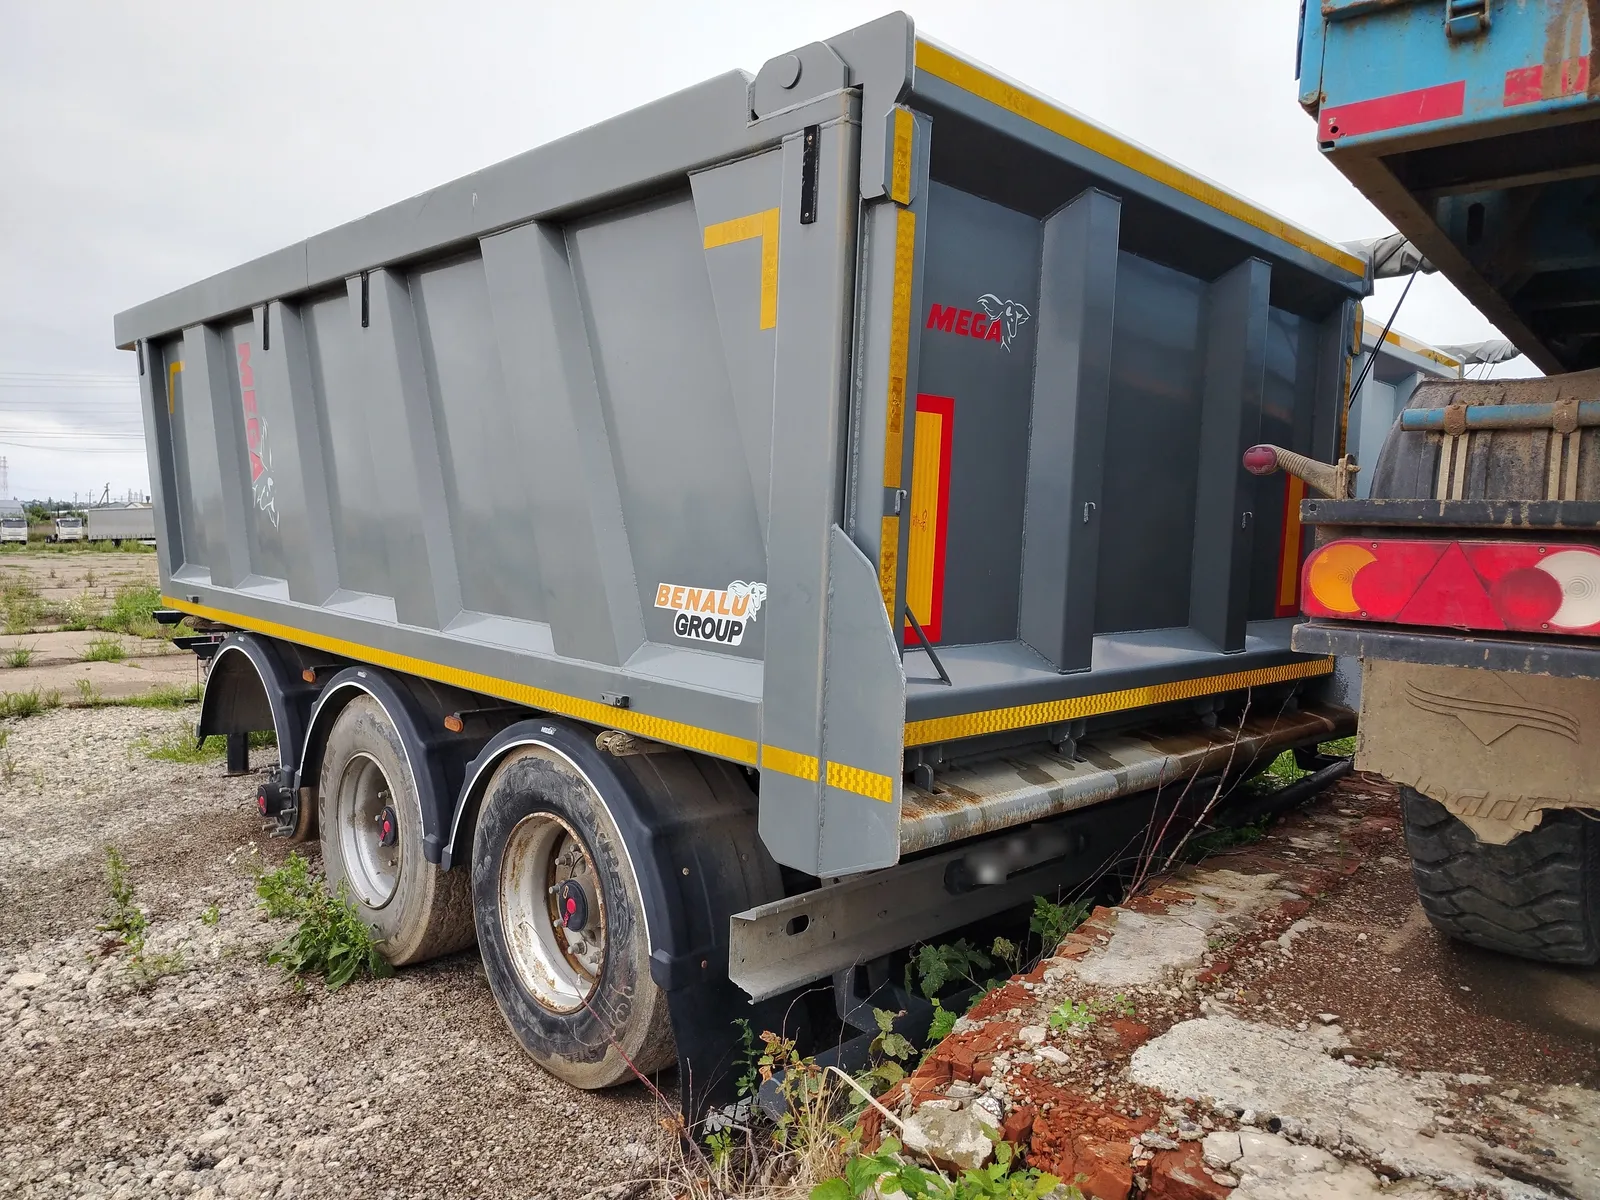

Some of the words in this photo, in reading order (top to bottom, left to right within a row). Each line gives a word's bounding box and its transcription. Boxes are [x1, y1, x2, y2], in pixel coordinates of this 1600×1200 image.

[926, 303, 1003, 342] MEGA
[238, 342, 264, 483] MEGA
[655, 584, 751, 617] BENALU
[675, 614, 743, 643] GROUP
